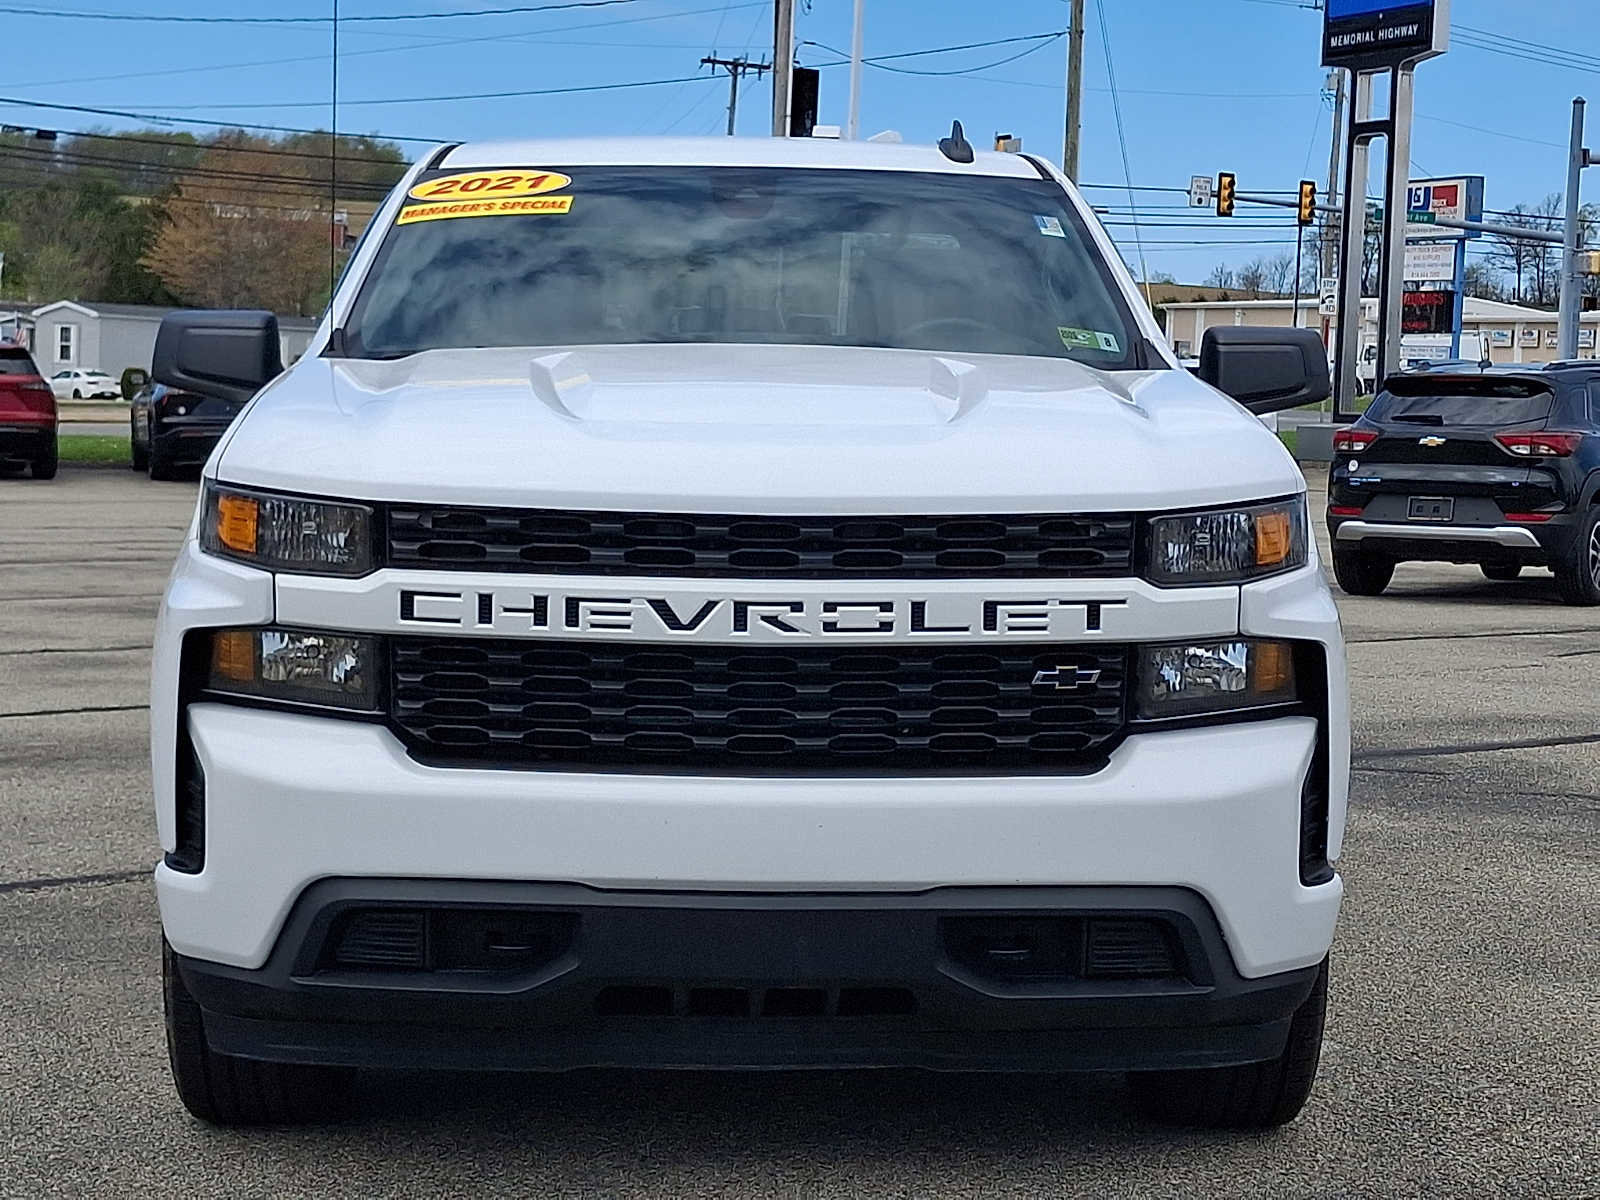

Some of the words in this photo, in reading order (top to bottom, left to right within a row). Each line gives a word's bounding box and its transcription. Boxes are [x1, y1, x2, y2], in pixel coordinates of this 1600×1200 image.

[1330, 30, 1375, 47] MEMORIAL
[1378, 24, 1419, 40] HIGHWAY
[424, 175, 550, 197] 2021
[403, 203, 495, 219] MANAGER'S
[500, 200, 568, 210] SPECIAL
[399, 589, 1127, 636] CHEVROLET
